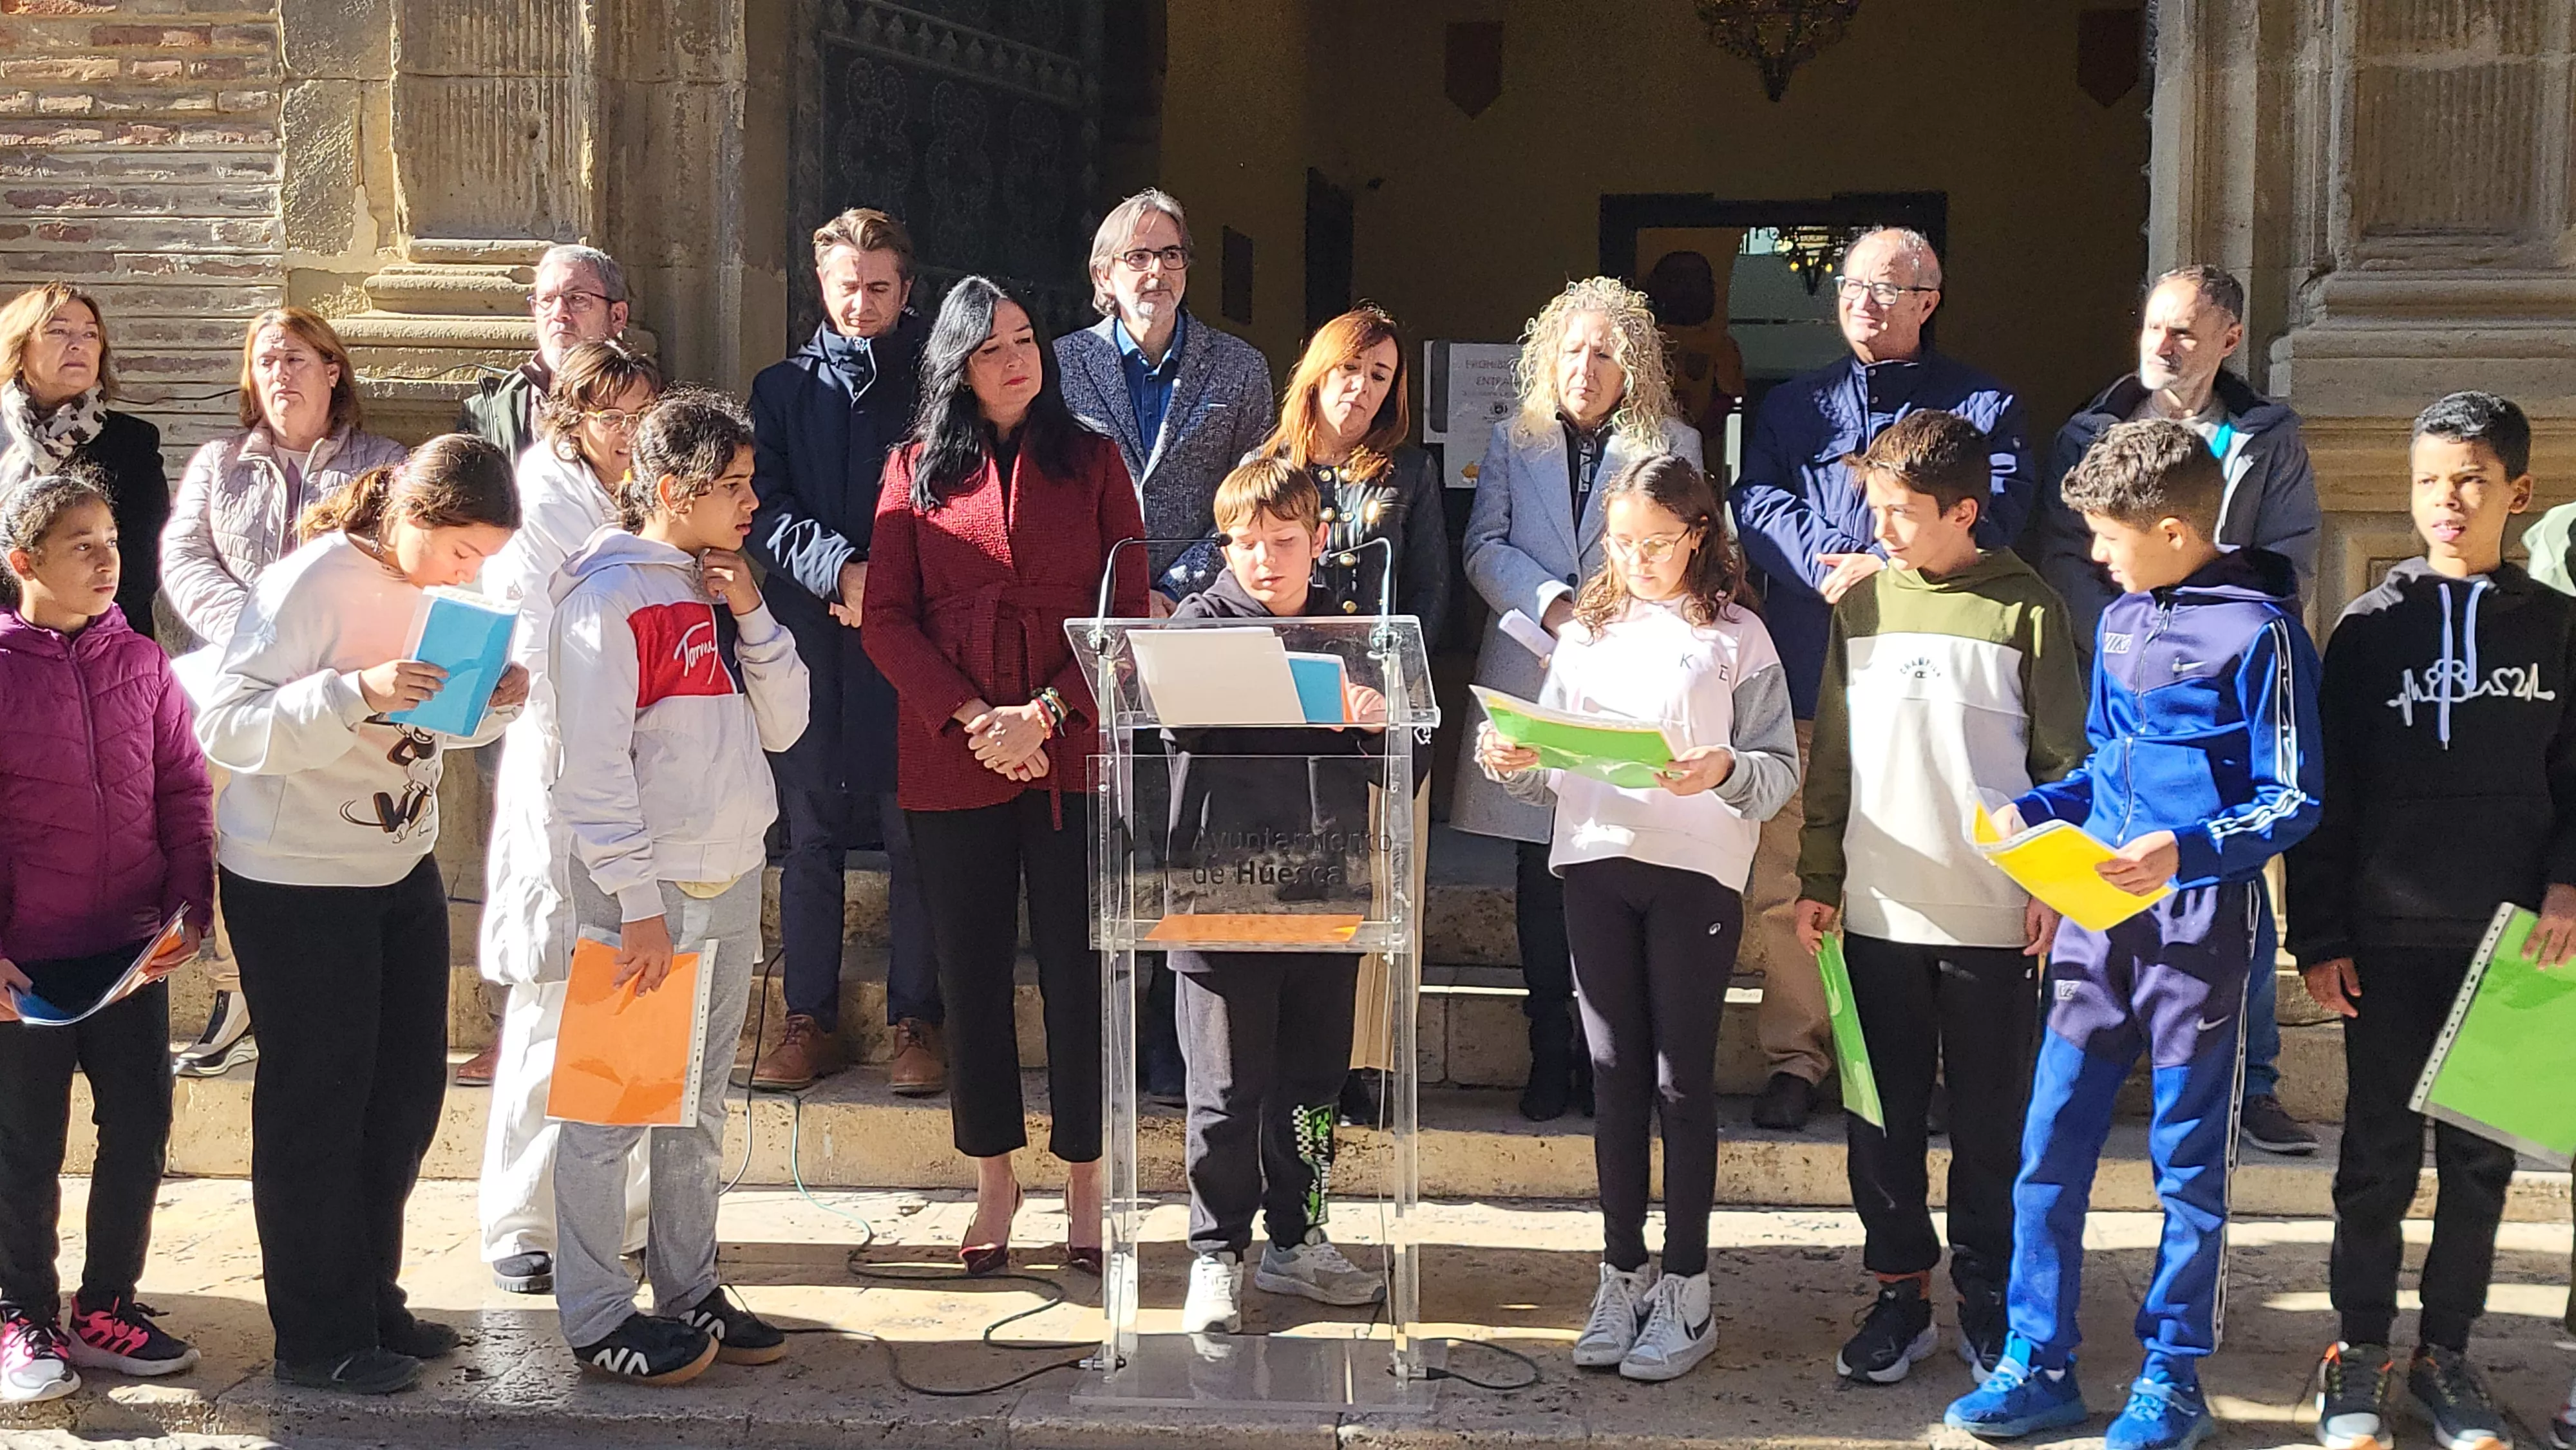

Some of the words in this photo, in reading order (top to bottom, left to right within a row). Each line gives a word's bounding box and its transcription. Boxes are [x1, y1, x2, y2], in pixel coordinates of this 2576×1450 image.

[1192, 827, 1392, 857] Ayuntamiento
[1193, 862, 1225, 885] de
[1236, 860, 1347, 885] Huesca
